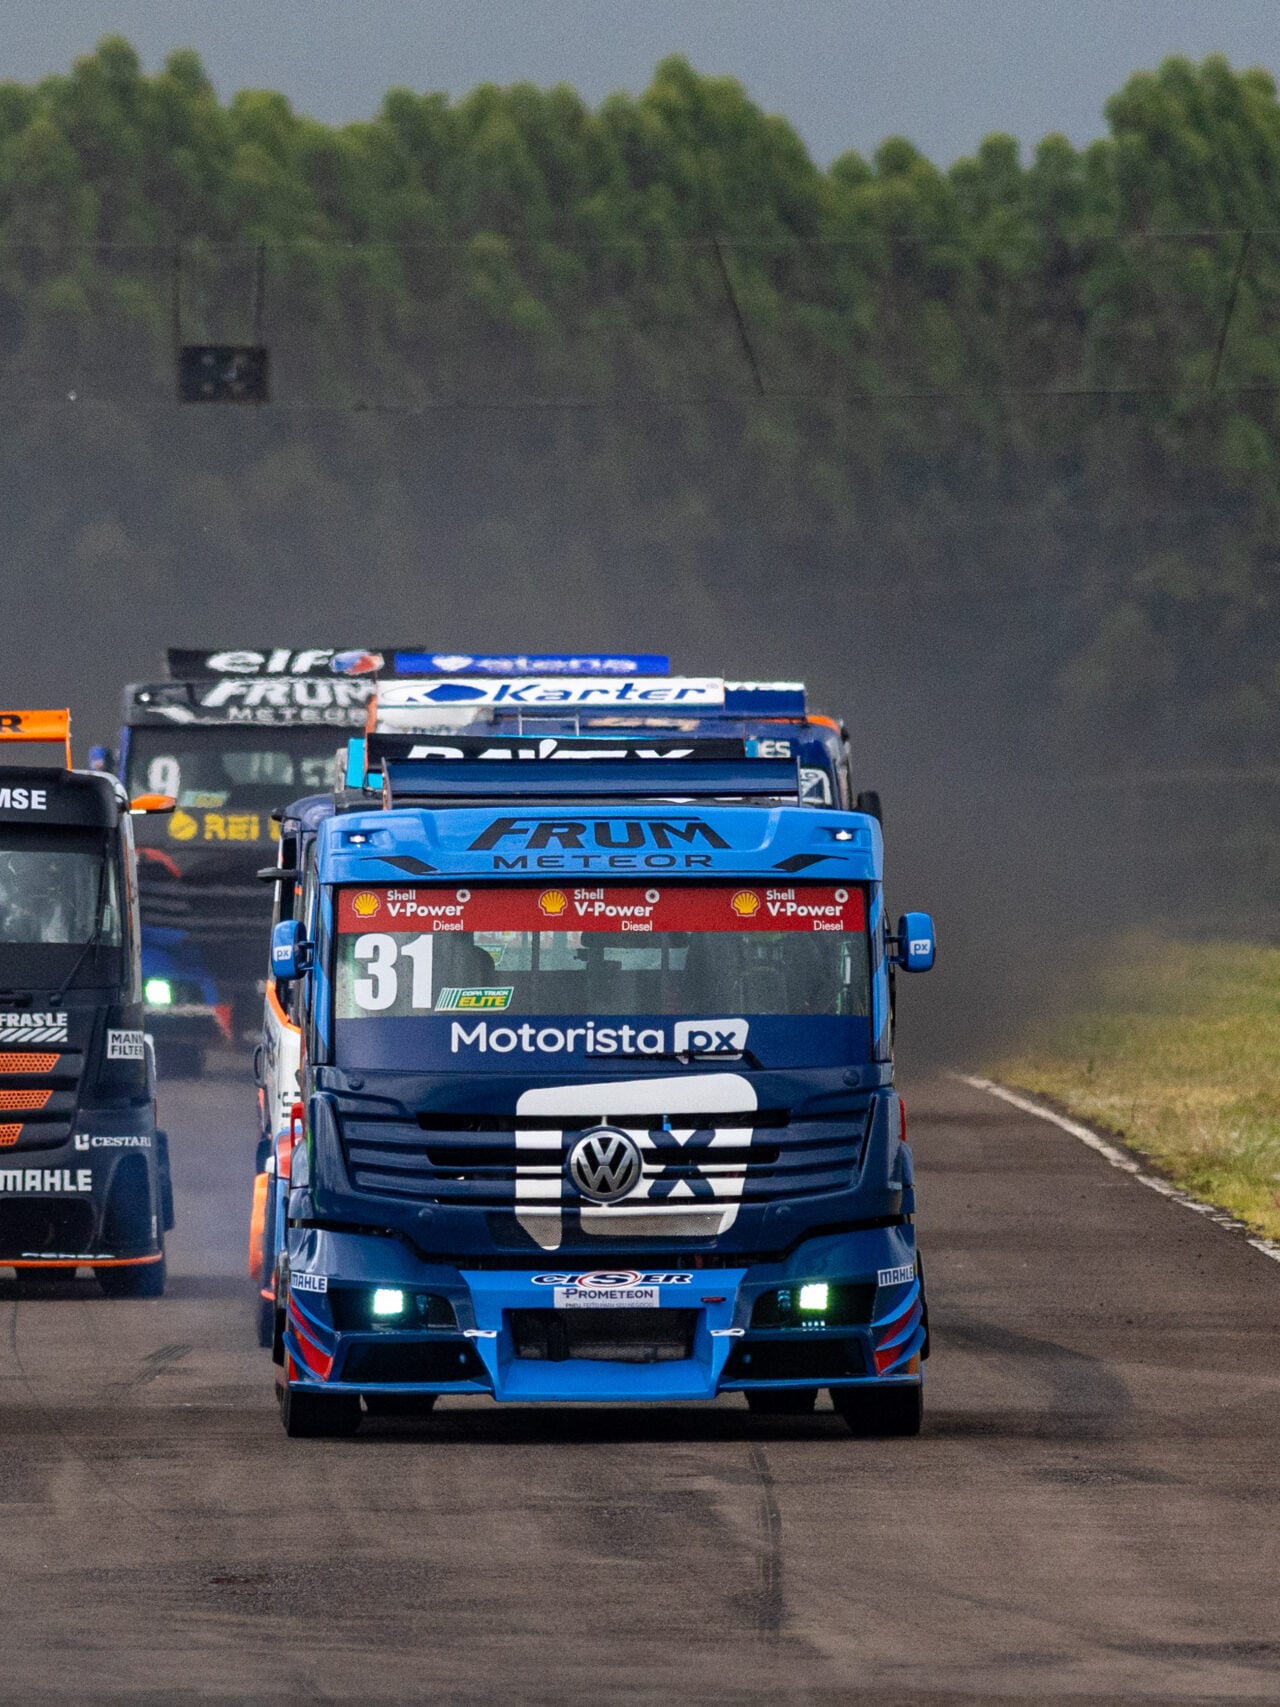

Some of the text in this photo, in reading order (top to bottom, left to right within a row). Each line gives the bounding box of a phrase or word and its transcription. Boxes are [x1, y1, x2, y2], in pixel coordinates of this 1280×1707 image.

[467, 816, 732, 850] FRUM
[494, 854, 712, 869] METEOR
[387, 890, 416, 900] Shell
[573, 889, 604, 900] Shell
[766, 889, 795, 900] Shell
[387, 903, 463, 917] V-Power
[574, 902, 653, 917] V-Power
[767, 902, 843, 916] V-Power
[432, 919, 464, 931] Diesel
[621, 920, 653, 931] Diesel
[813, 920, 844, 931] Diesel
[354, 933, 433, 1011] 31
[458, 995, 507, 1007] ELITE
[451, 1021, 737, 1054] Motorista px
[91, 1136, 152, 1147] CESTARI
[531, 1271, 694, 1287] CISER
[880, 1265, 914, 1285] MAHLE
[561, 1288, 654, 1299] PROMETEON
